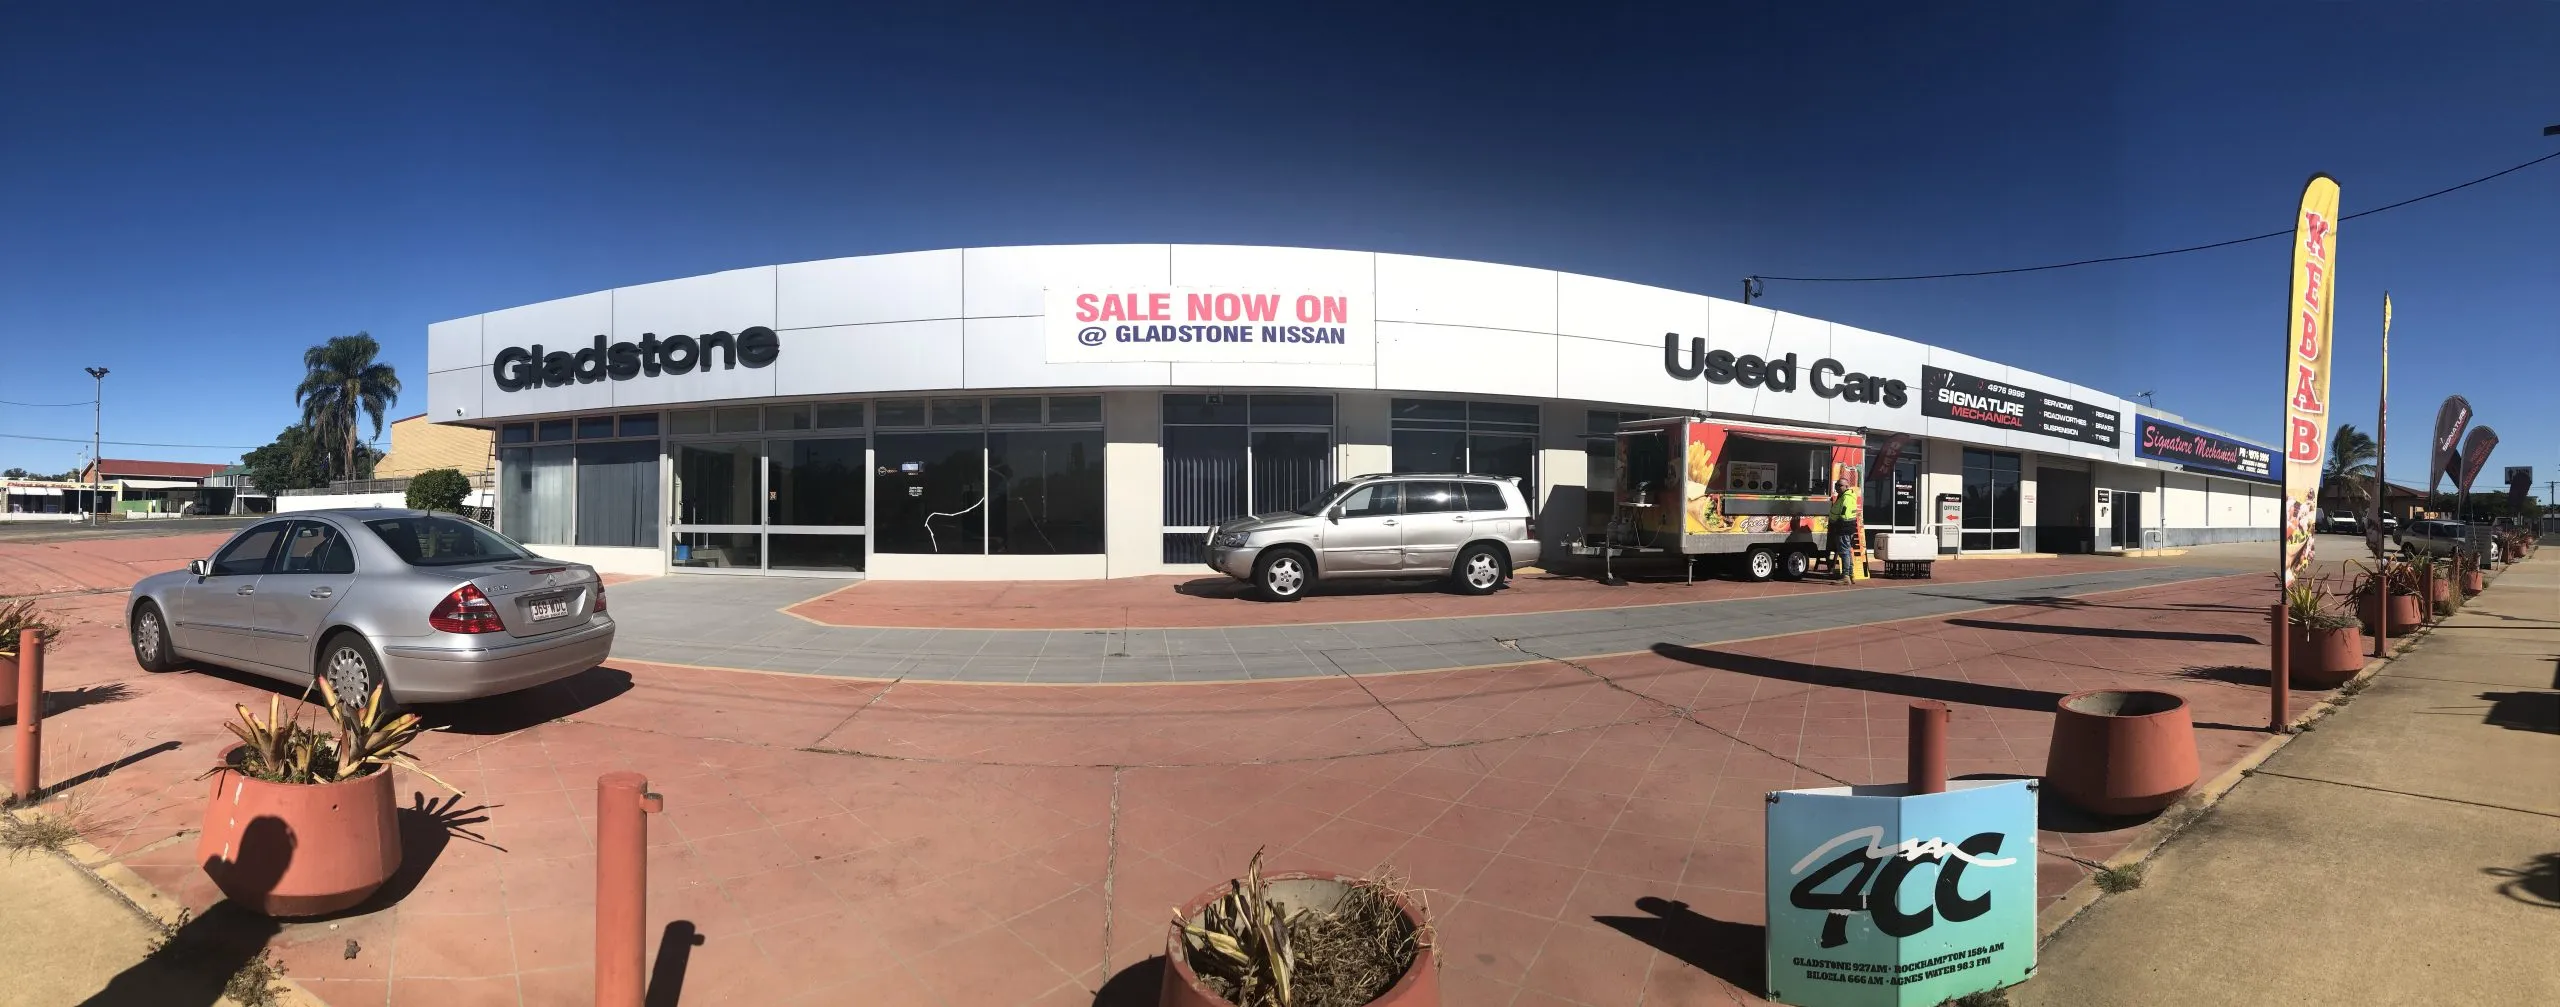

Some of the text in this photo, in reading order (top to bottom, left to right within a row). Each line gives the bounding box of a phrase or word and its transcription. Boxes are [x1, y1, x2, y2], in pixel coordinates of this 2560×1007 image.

[1076, 293, 1347, 323] SALE NOW ON
[1078, 325, 1345, 346] @ GLADSTONE NISSAN
[2289, 212, 2328, 464] KEBAB
[493, 326, 780, 392] Gladstone
[1664, 332, 1908, 408] Used Cars
[1988, 383, 2025, 398] 4976 9996
[1938, 388, 2024, 417] SIGNATURE
[2043, 398, 2074, 411] SERVICING
[1951, 405, 2022, 427] MECHANICAL
[2095, 411, 2115, 421] REPAIRS
[2095, 422, 2115, 432] BRAKES
[2043, 423, 2079, 436] SUSPENSION
[2095, 434, 2111, 443] TYRES
[2144, 424, 2238, 463] Signature Mechanical
[1740, 517, 1769, 532] Great
[1793, 957, 1852, 971] GLADSTONE
[1894, 950, 1966, 974] ROCKHAMPTON
[1967, 946, 1988, 958] 1584
[1989, 942, 2005, 953] AM
[1806, 970, 1846, 982] BILOELA
[1847, 975, 1867, 984] 666
[1868, 976, 1884, 985] AM
[1890, 974, 1923, 986] AGNES
[1924, 965, 1956, 980] WATER
[1976, 956, 1991, 967] FM
